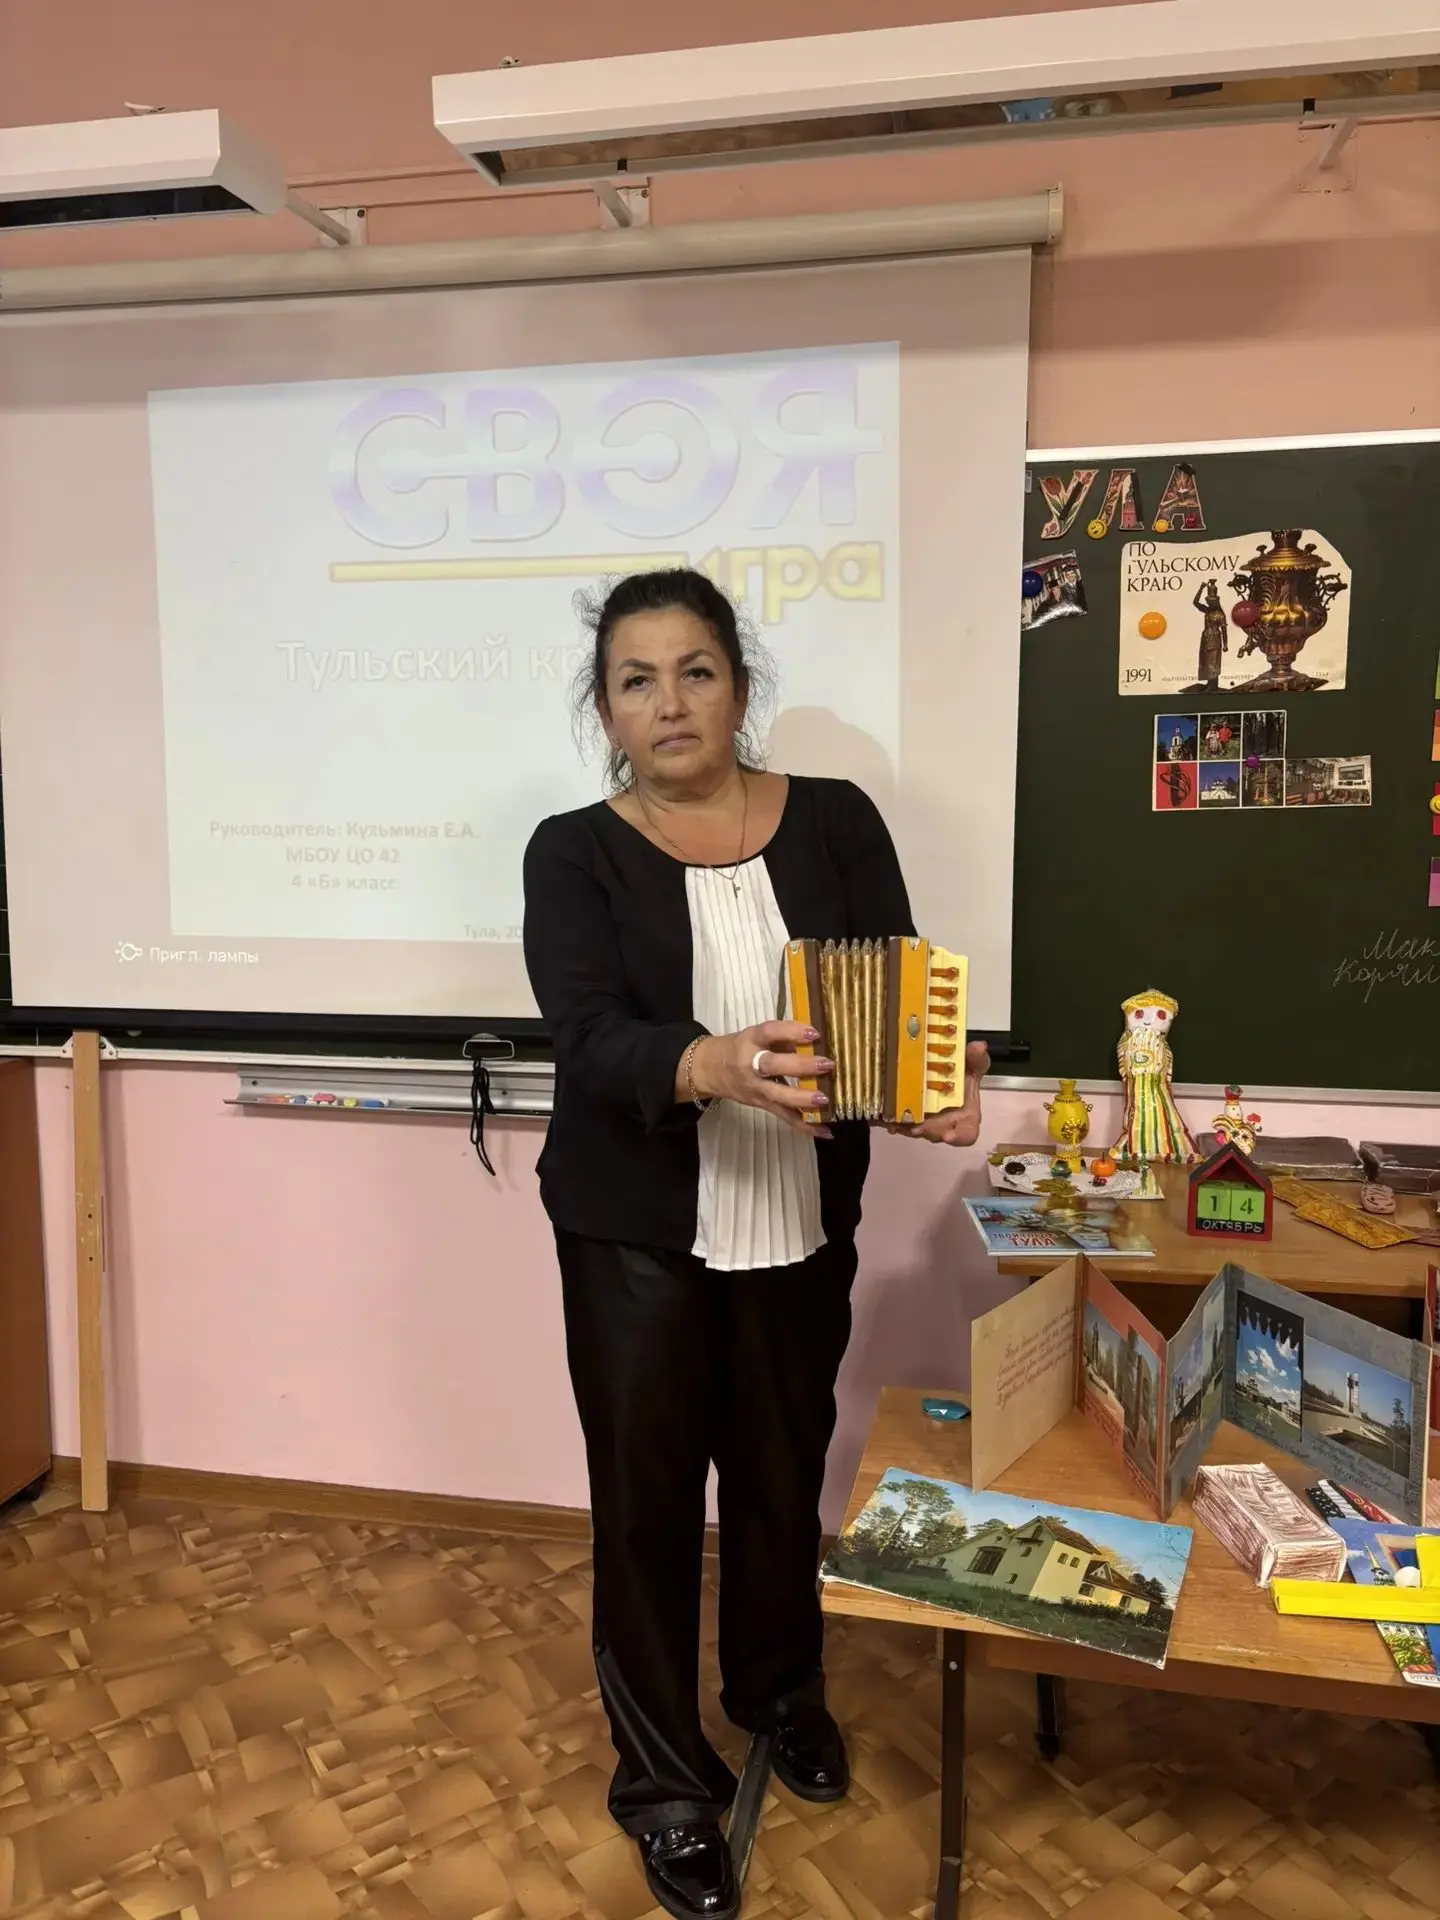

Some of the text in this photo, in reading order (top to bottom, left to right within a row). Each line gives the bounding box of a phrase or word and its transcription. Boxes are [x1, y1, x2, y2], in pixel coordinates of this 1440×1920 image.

[1026, 463, 1206, 540] УЛА
[1129, 542, 1156, 557] ПО
[1127, 576, 1183, 592] КРАЮ
[276, 634, 590, 692] Тульский кр
[1125, 668, 1152, 683] 1991
[210, 820, 481, 840] Руководитель: Кузьмина Е.А.
[286, 846, 402, 866] МБОУ ЦО 42
[291, 873, 397, 890] 4 «Б» класс
[464, 924, 524, 940] Тула, 20
[150, 946, 259, 964] Пригл. лампы
[1202, 1219, 1262, 1233] ОКТЯБРЬ
[1011, 1237, 1057, 1247] ТУЛА
